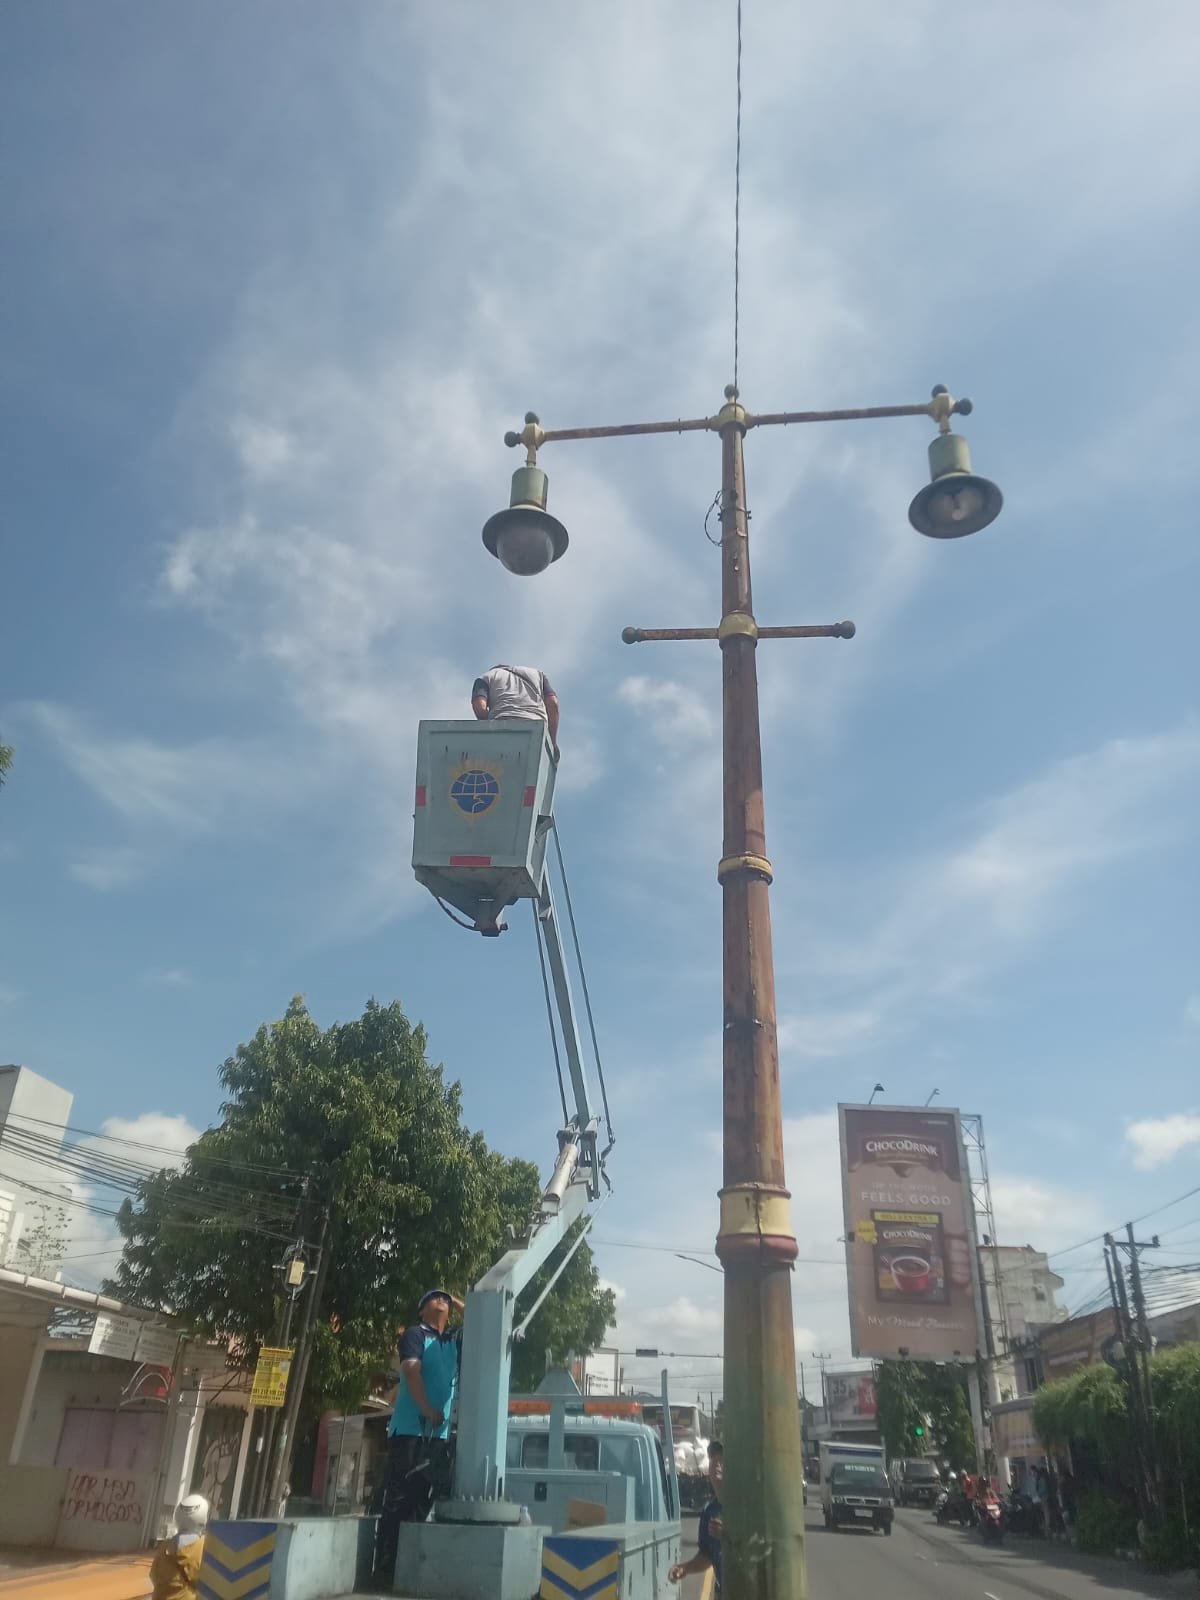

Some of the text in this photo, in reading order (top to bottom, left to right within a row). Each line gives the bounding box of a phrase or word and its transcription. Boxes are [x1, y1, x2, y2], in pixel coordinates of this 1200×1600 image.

[865, 1140, 938, 1156] CHOCODRINK
[861, 1191, 952, 1206] FEELS GOOD
